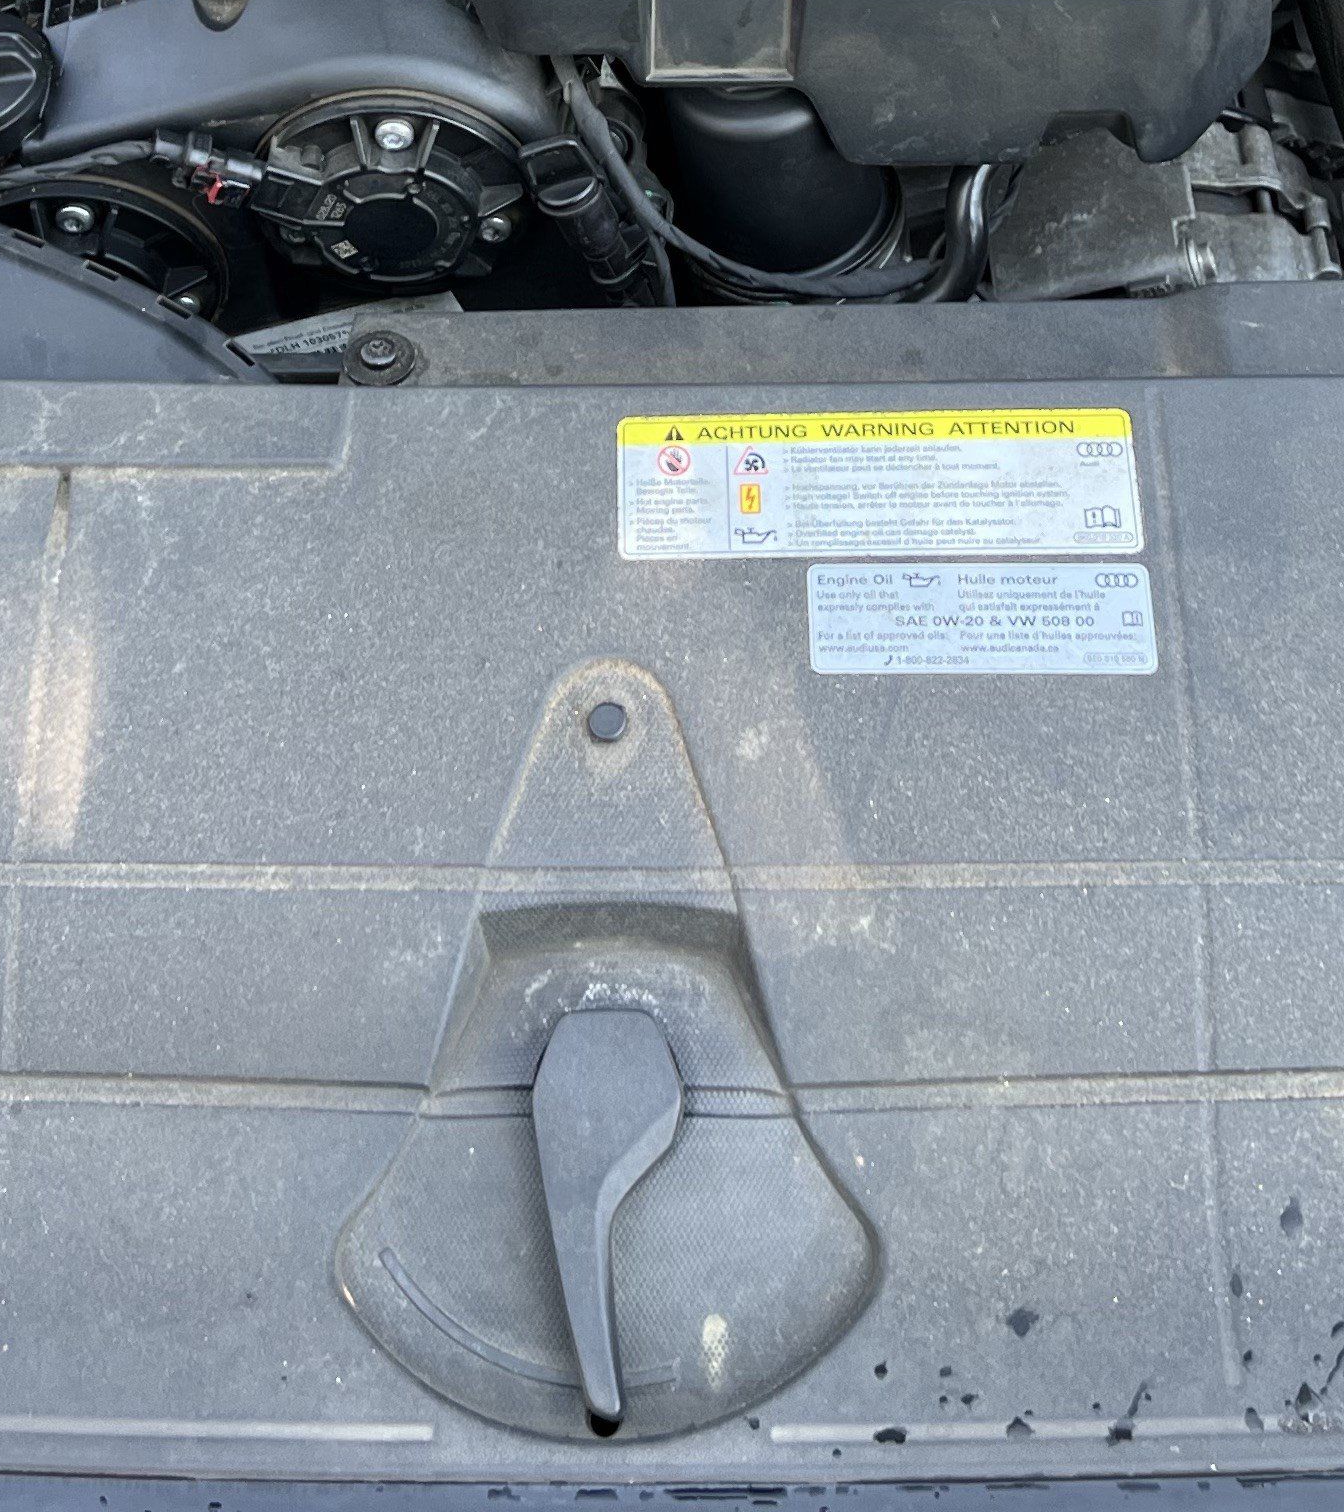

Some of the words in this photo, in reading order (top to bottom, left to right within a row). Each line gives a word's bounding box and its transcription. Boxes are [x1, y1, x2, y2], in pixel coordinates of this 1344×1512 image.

[697, 424, 807, 440] ACHTUNG
[821, 421, 934, 438] WARNING
[949, 419, 1075, 436] ATTENTION
[817, 574, 868, 588] Engine
[873, 573, 894, 585] Oil
[957, 573, 996, 585] Huile
[1000, 573, 1058, 585] moteur
[816, 590, 837, 599] Use
[838, 589, 861, 601] only
[863, 589, 877, 599] oil
[879, 589, 900, 599] that
[957, 589, 994, 599] Utilisez
[996, 589, 1057, 600] uniquement
[1059, 589, 1073, 599] de
[817, 602, 864, 613] expressly
[865, 602, 910, 613] complies
[913, 601, 935, 611] with
[958, 602, 975, 612] qui
[977, 601, 1017, 611] satisfait
[894, 615, 928, 627] SAE
[932, 615, 984, 627] 0W-20
[989, 615, 1002, 627] &
[1007, 615, 1037, 627] VW
[1075, 615, 1095, 627] 00
[817, 630, 834, 640] For
[863, 630, 875, 640] of
[877, 630, 925, 642] approved
[959, 630, 984, 640] Pour
[986, 631, 1006, 640] une
[1008, 630, 1029, 640] liste
